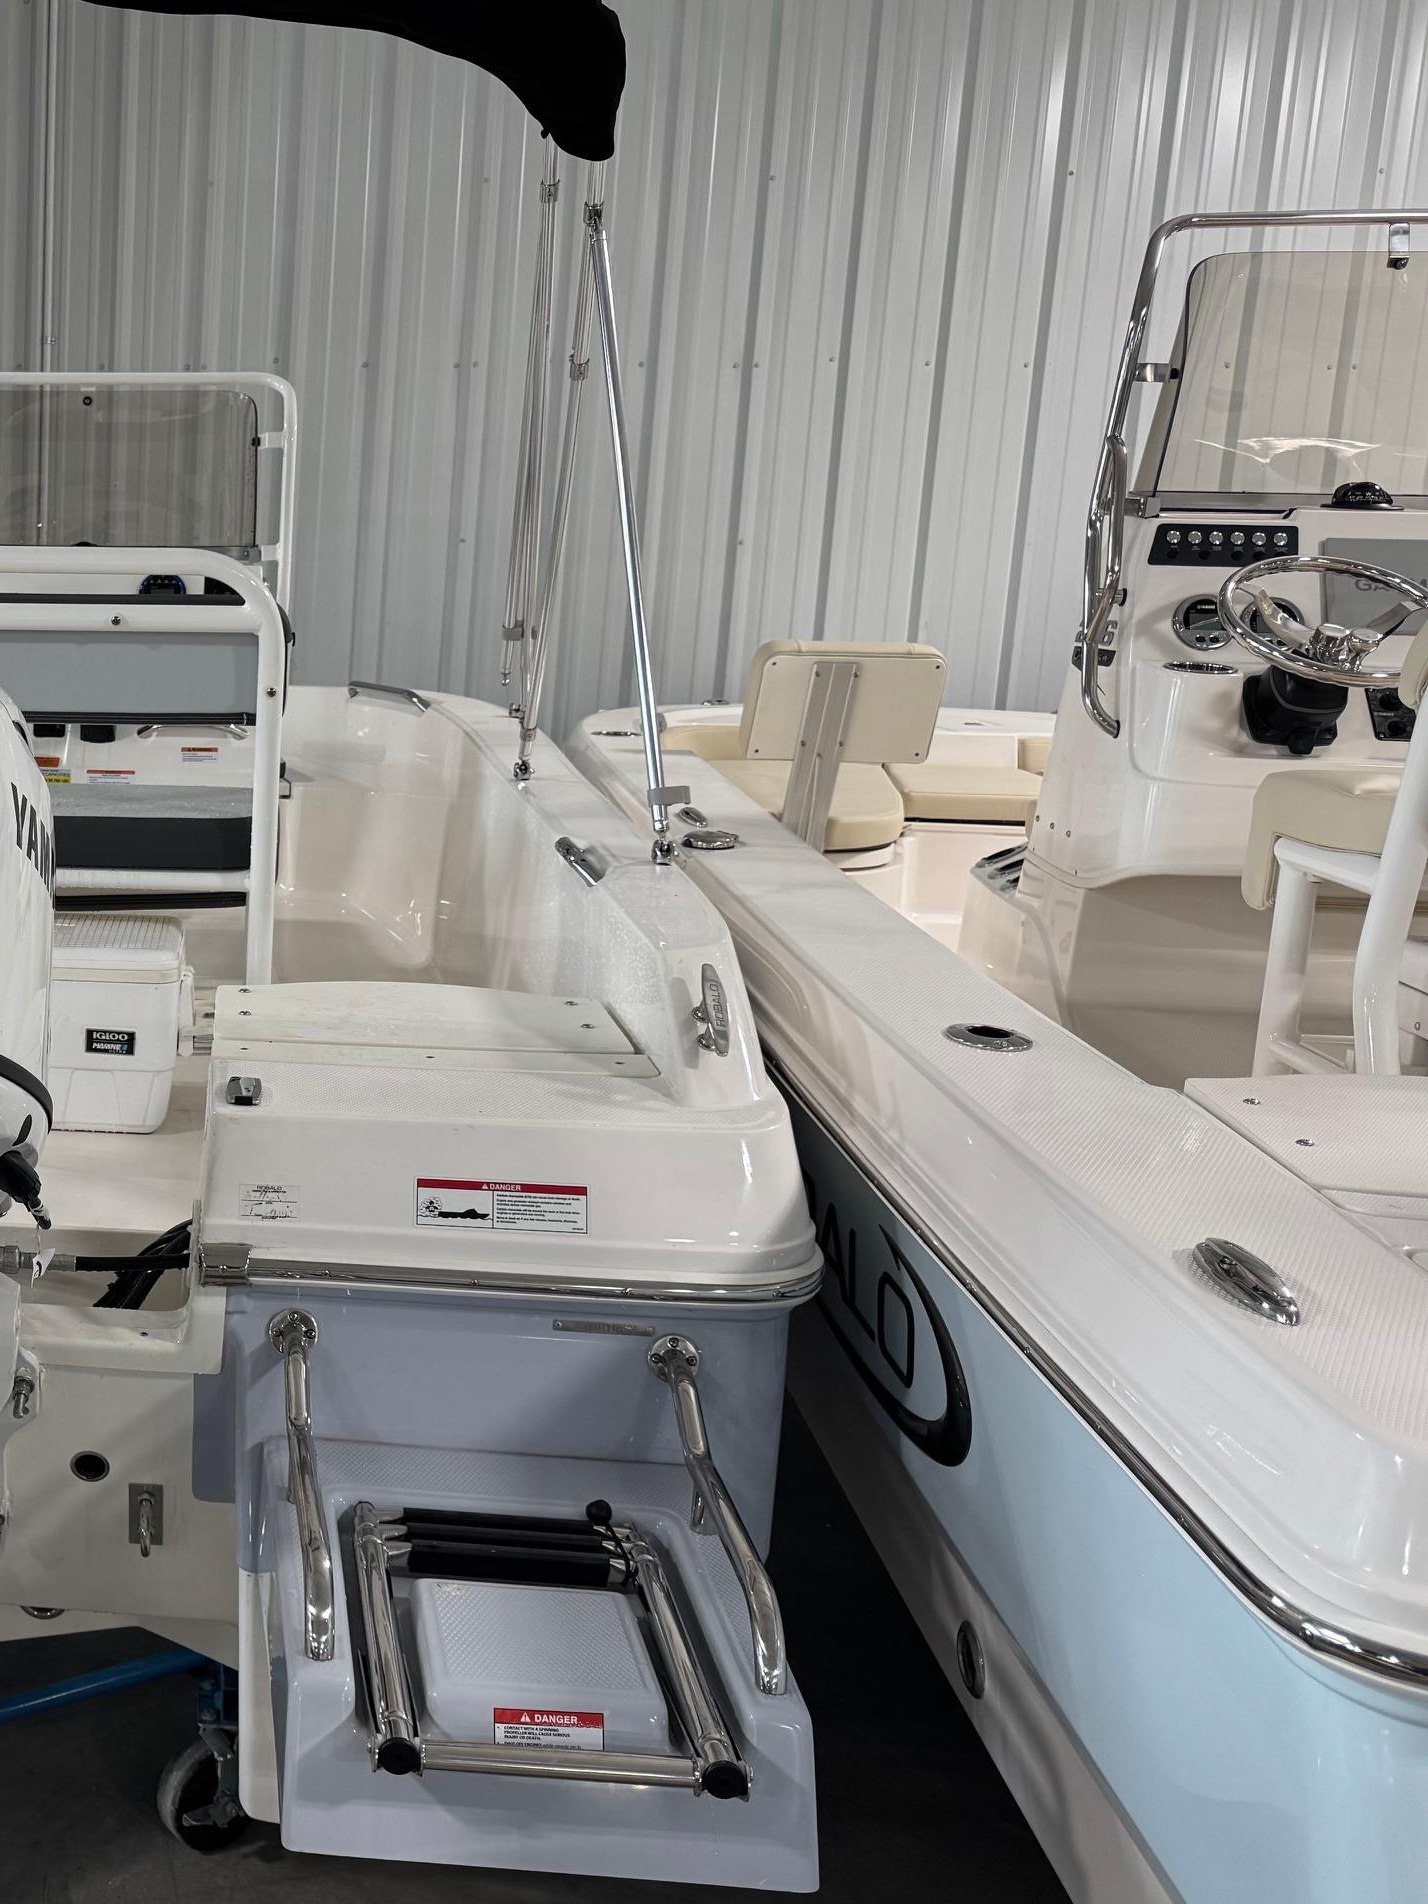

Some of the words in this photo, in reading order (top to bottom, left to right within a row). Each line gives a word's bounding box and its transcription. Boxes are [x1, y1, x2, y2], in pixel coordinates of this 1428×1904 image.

[709, 983, 726, 1028] ROBALO
[92, 1031, 128, 1041] IGLOO
[534, 1714, 578, 1724] DANGER
